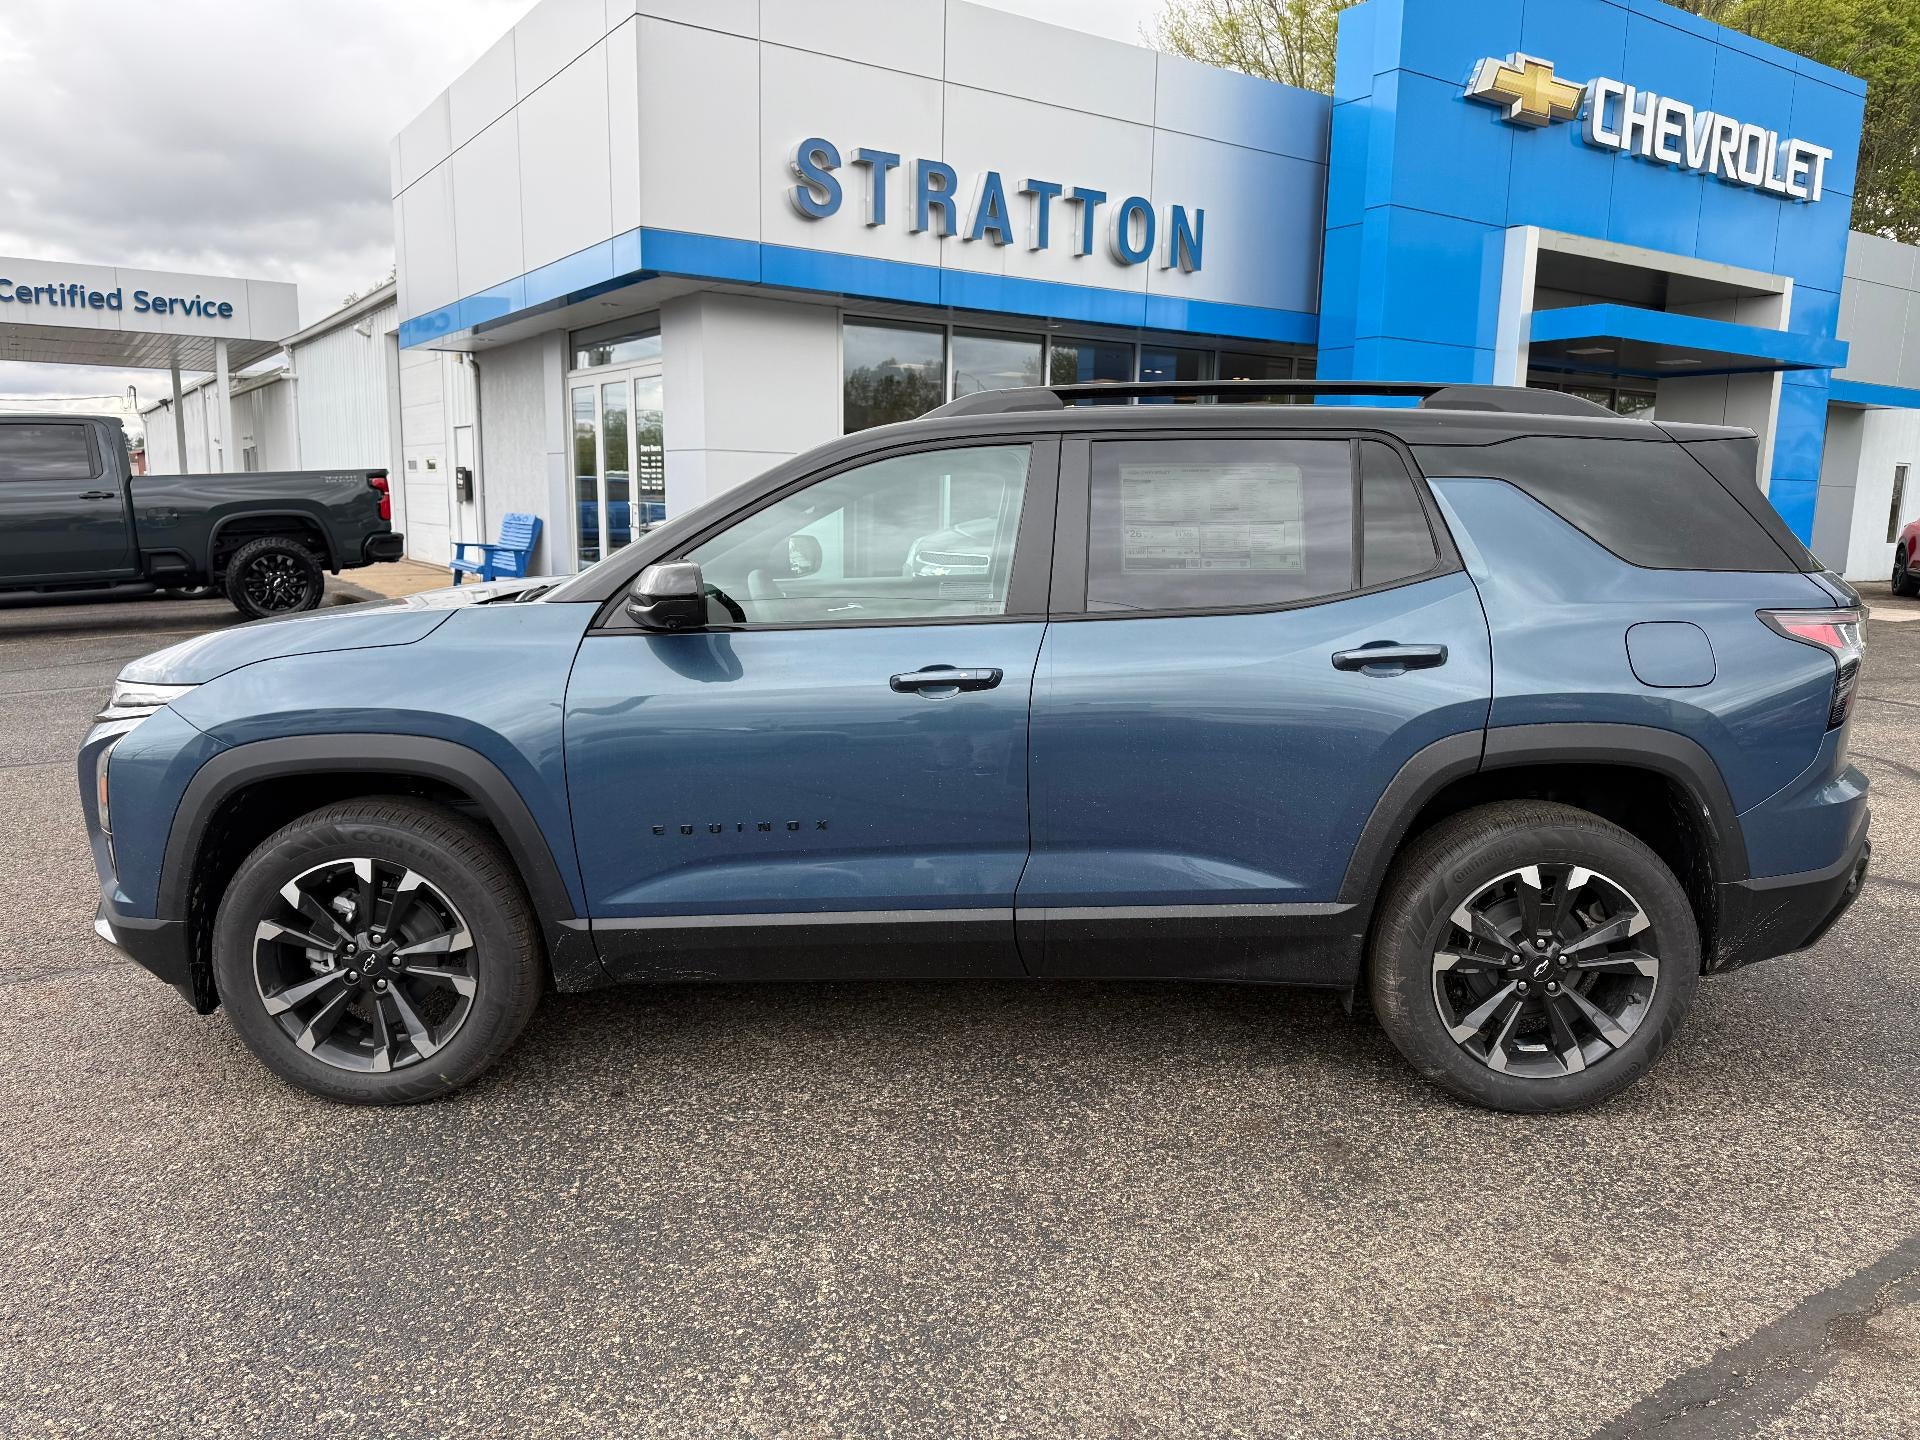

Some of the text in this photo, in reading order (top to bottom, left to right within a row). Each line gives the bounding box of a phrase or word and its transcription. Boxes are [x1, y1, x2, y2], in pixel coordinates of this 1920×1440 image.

[1582, 76, 1833, 202] CHEVROLET
[788, 137, 1206, 273] STRATTON
[0, 278, 234, 319] Certified Service
[652, 819, 828, 836] EQUINOX
